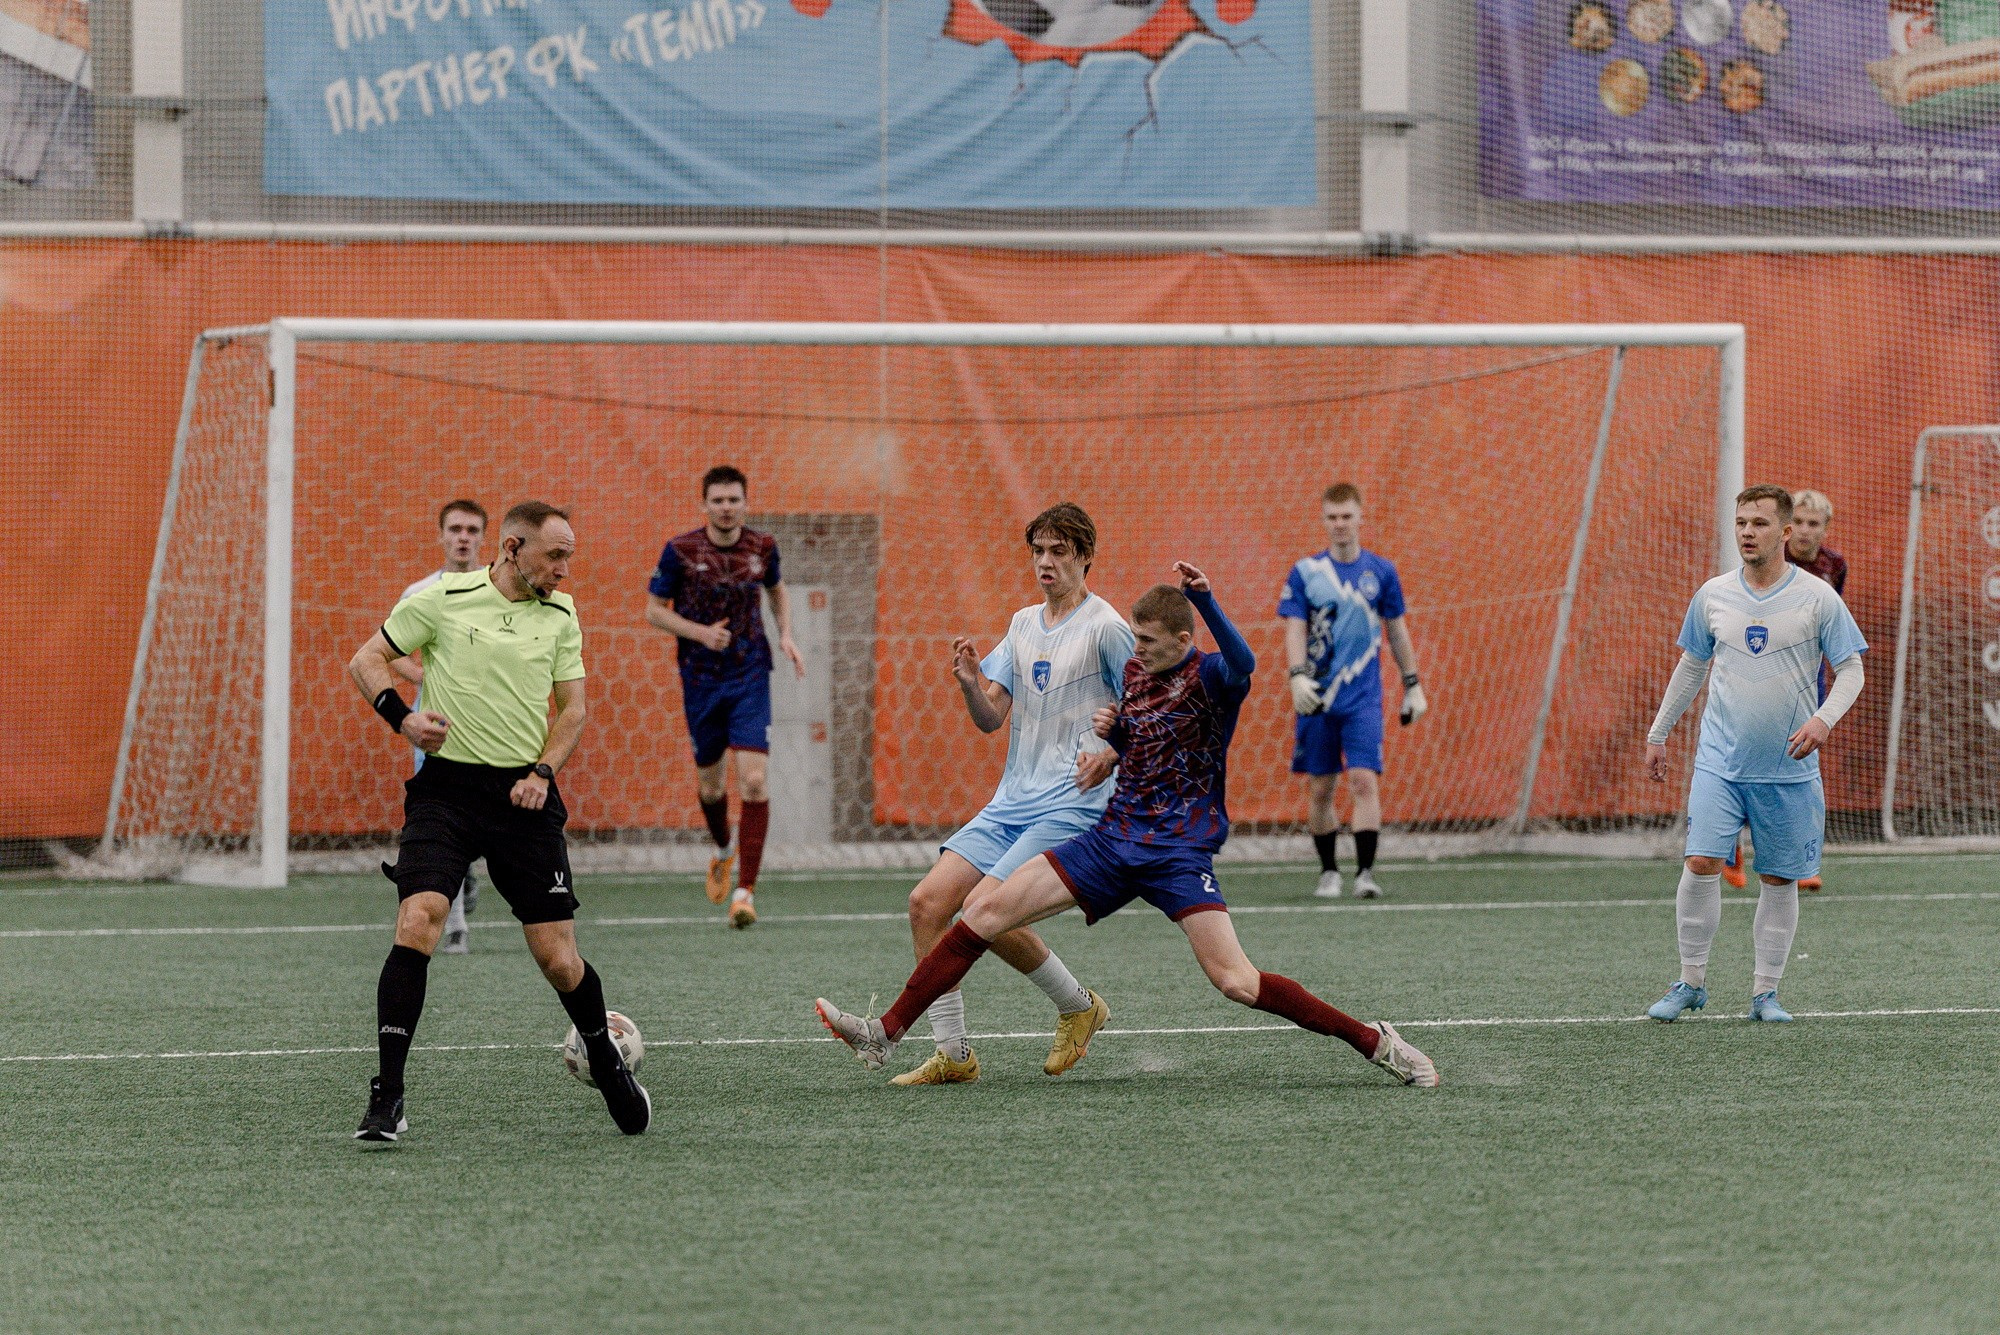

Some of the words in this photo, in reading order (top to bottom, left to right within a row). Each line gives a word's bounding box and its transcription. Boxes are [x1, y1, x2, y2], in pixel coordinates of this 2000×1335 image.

[323, 44, 517, 137] ПАРТНЕР
[525, 22, 599, 88] ФК
[609, 0, 767, 67] «ТЕМП»
[1200, 872, 1216, 893] 2
